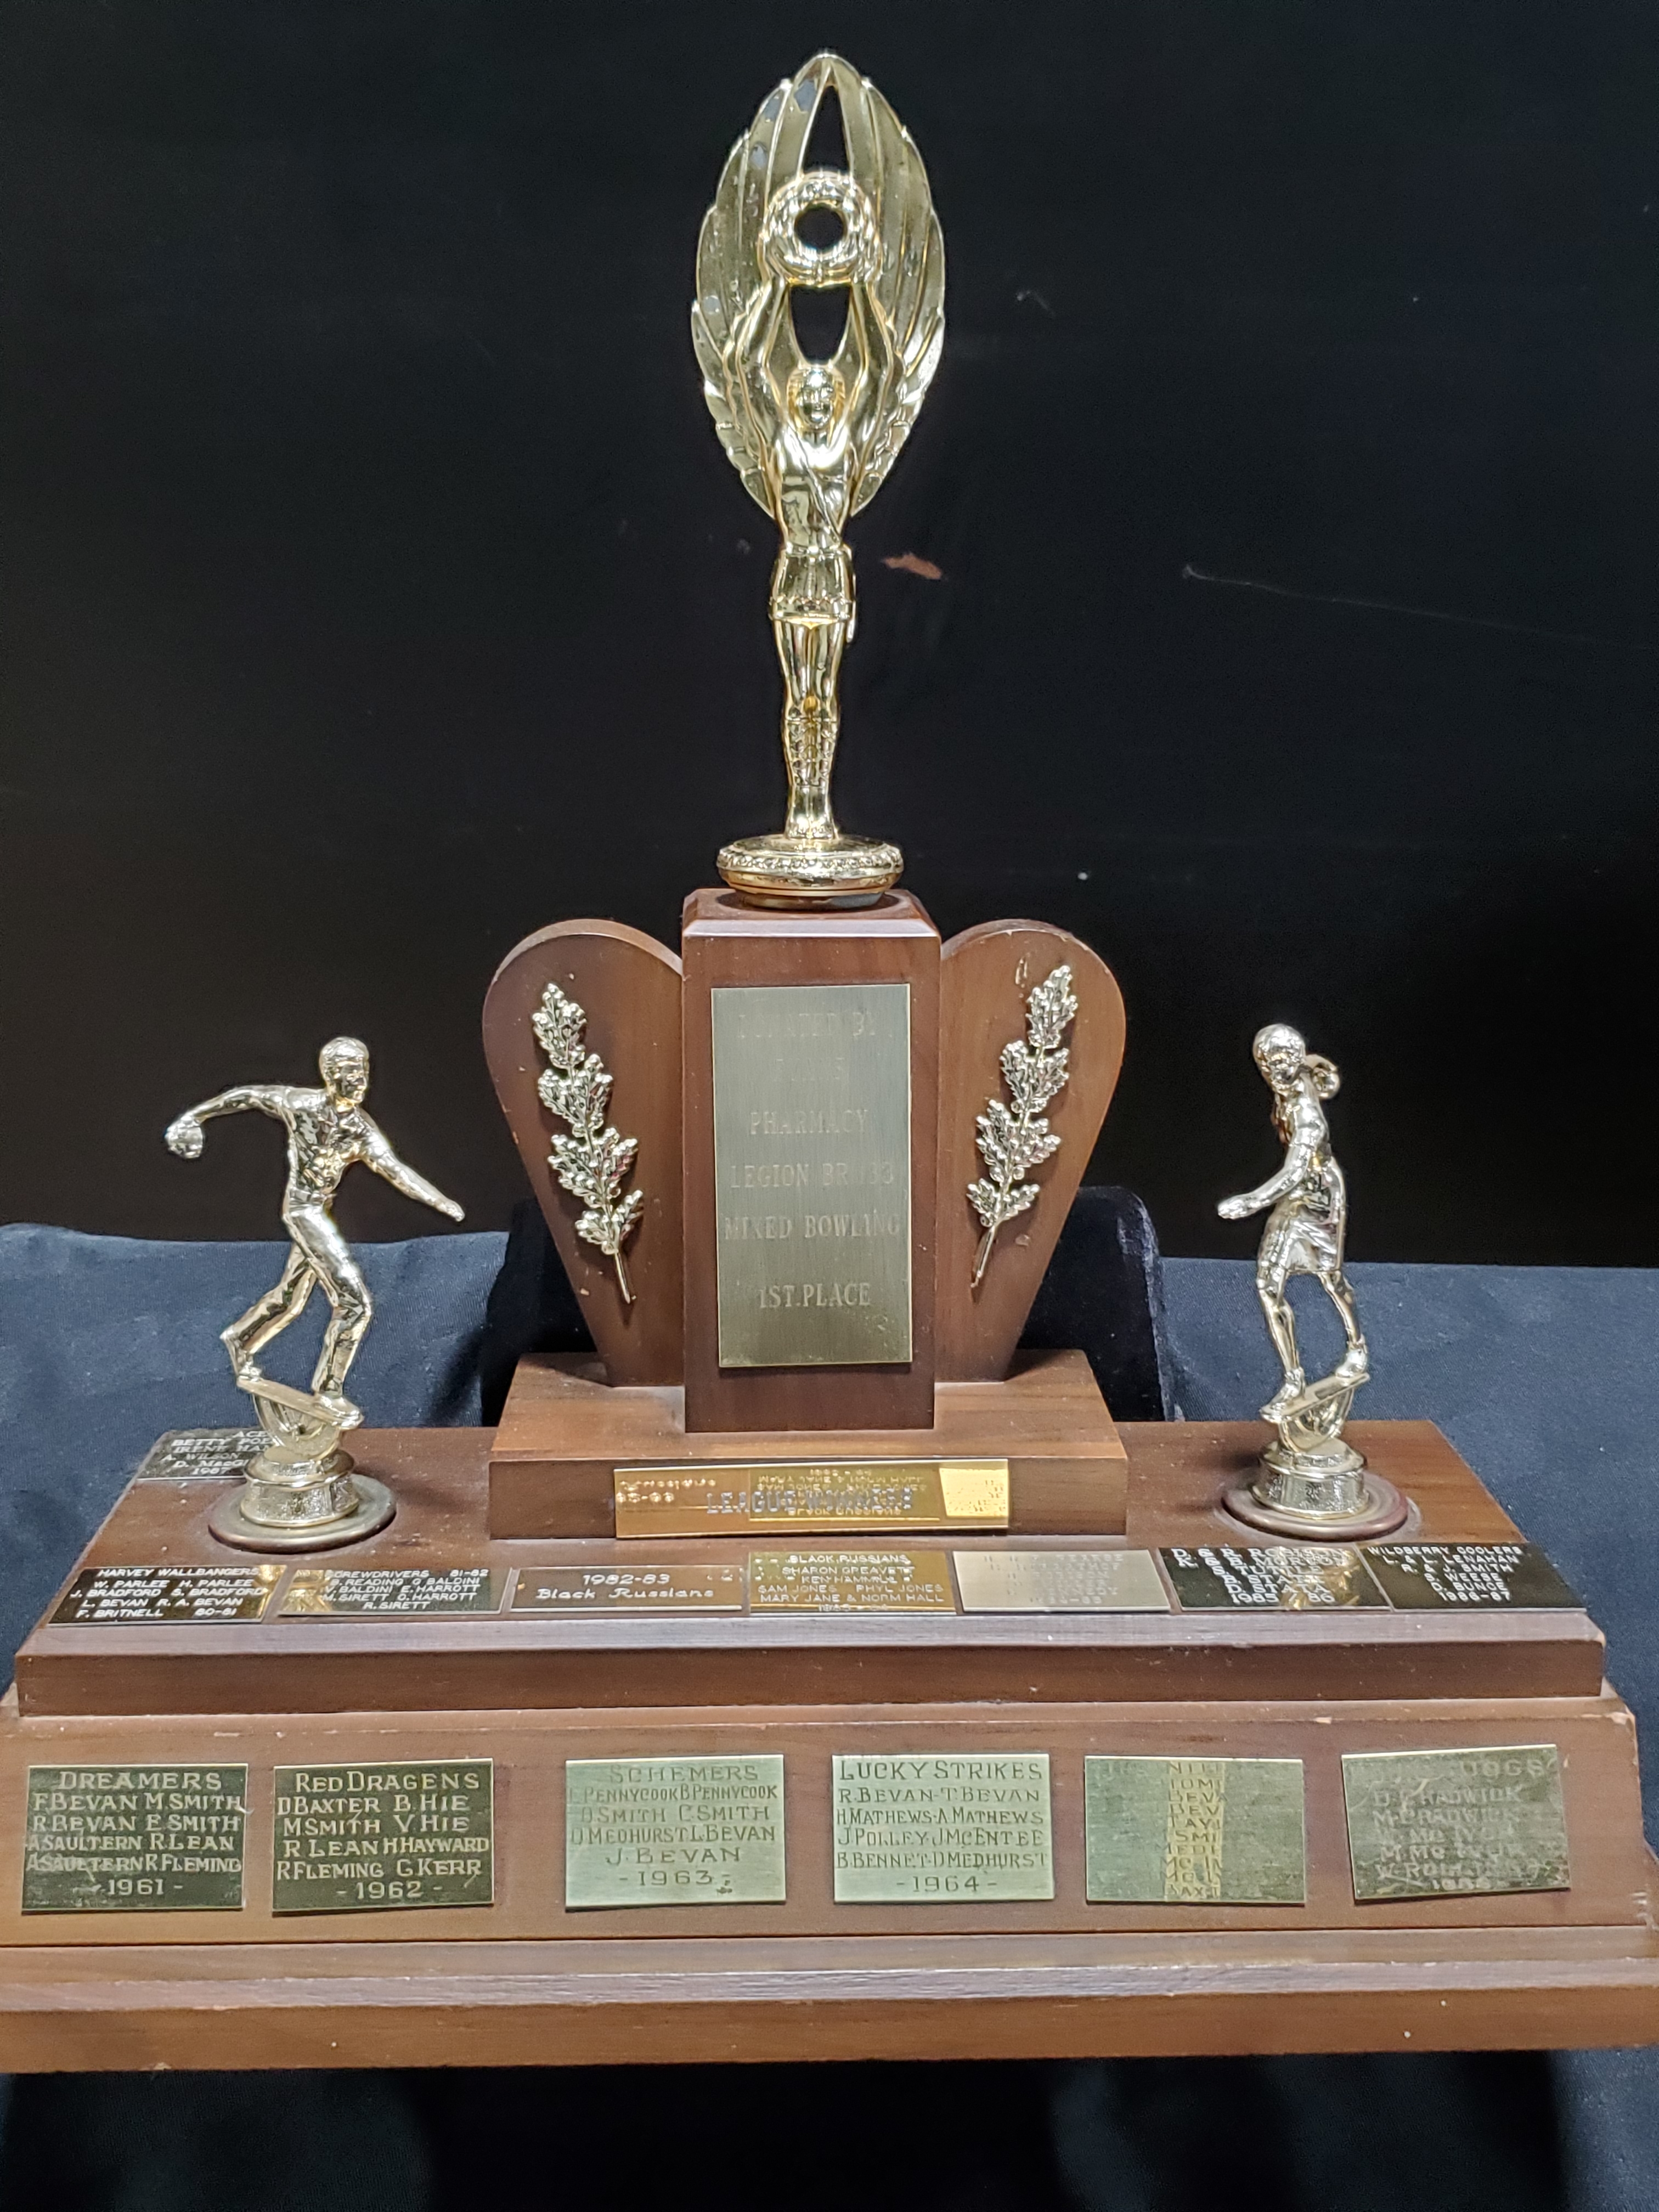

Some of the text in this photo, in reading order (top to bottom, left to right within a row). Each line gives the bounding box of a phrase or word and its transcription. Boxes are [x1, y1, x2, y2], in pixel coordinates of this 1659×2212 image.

[730, 1162, 809, 1189] LEGION
[724, 1212, 900, 1241] MIXED BOWLING
[171, 1438, 233, 1447] BETTY
[1367, 1546, 1523, 1555] WILDBERRY COOLERS
[789, 1554, 910, 1564] BLACK RUSSIANS
[1383, 1555, 1398, 1565] L.
[1421, 1555, 1438, 1564] L.
[1442, 1555, 1521, 1564] LENAHAN
[97, 1568, 154, 1577] HARVEY
[450, 1569, 489, 1577] 81-82
[782, 1566, 838, 1575] SHARON
[1234, 1565, 1325, 1575] TUTTLE
[1401, 1564, 1419, 1574] R.
[1442, 1564, 1457, 1573] J.
[1461, 1563, 1515, 1573] SMITH
[582, 1573, 671, 1585] 1982-83
[801, 1576, 831, 1584] KEN
[1424, 1572, 1503, 1582] S. WEESE
[93, 1579, 255, 1589] W. PARLEE H. PARLEE
[758, 1584, 944, 1593] SAM JONES PHYL JONES
[1252, 1583, 1330, 1594] STATA
[1453, 1581, 1508, 1591] BUNCE
[70, 1587, 265, 1598] J. BRADFORD S. BRADFORD
[535, 1587, 714, 1600] Black Russians
[760, 1593, 945, 1602] MARY JANE & NORM HALL
[1438, 1591, 1512, 1601] 1986-87
[80, 1599, 95, 1607] L.
[99, 1598, 149, 1607] BEVAN
[193, 1597, 244, 1606] BEVAN
[1231, 1593, 1279, 1604] 1985
[1307, 1593, 1336, 1602] 86
[75, 1609, 90, 1618] F.
[93, 1607, 164, 1617] BRITNELL
[609, 1764, 759, 1784] SCHEMERS
[839, 1760, 1042, 1781] LUCKY STRIKES
[58, 1771, 222, 1791] DREAMERS
[296, 1771, 479, 1793] RED DRAGENS
